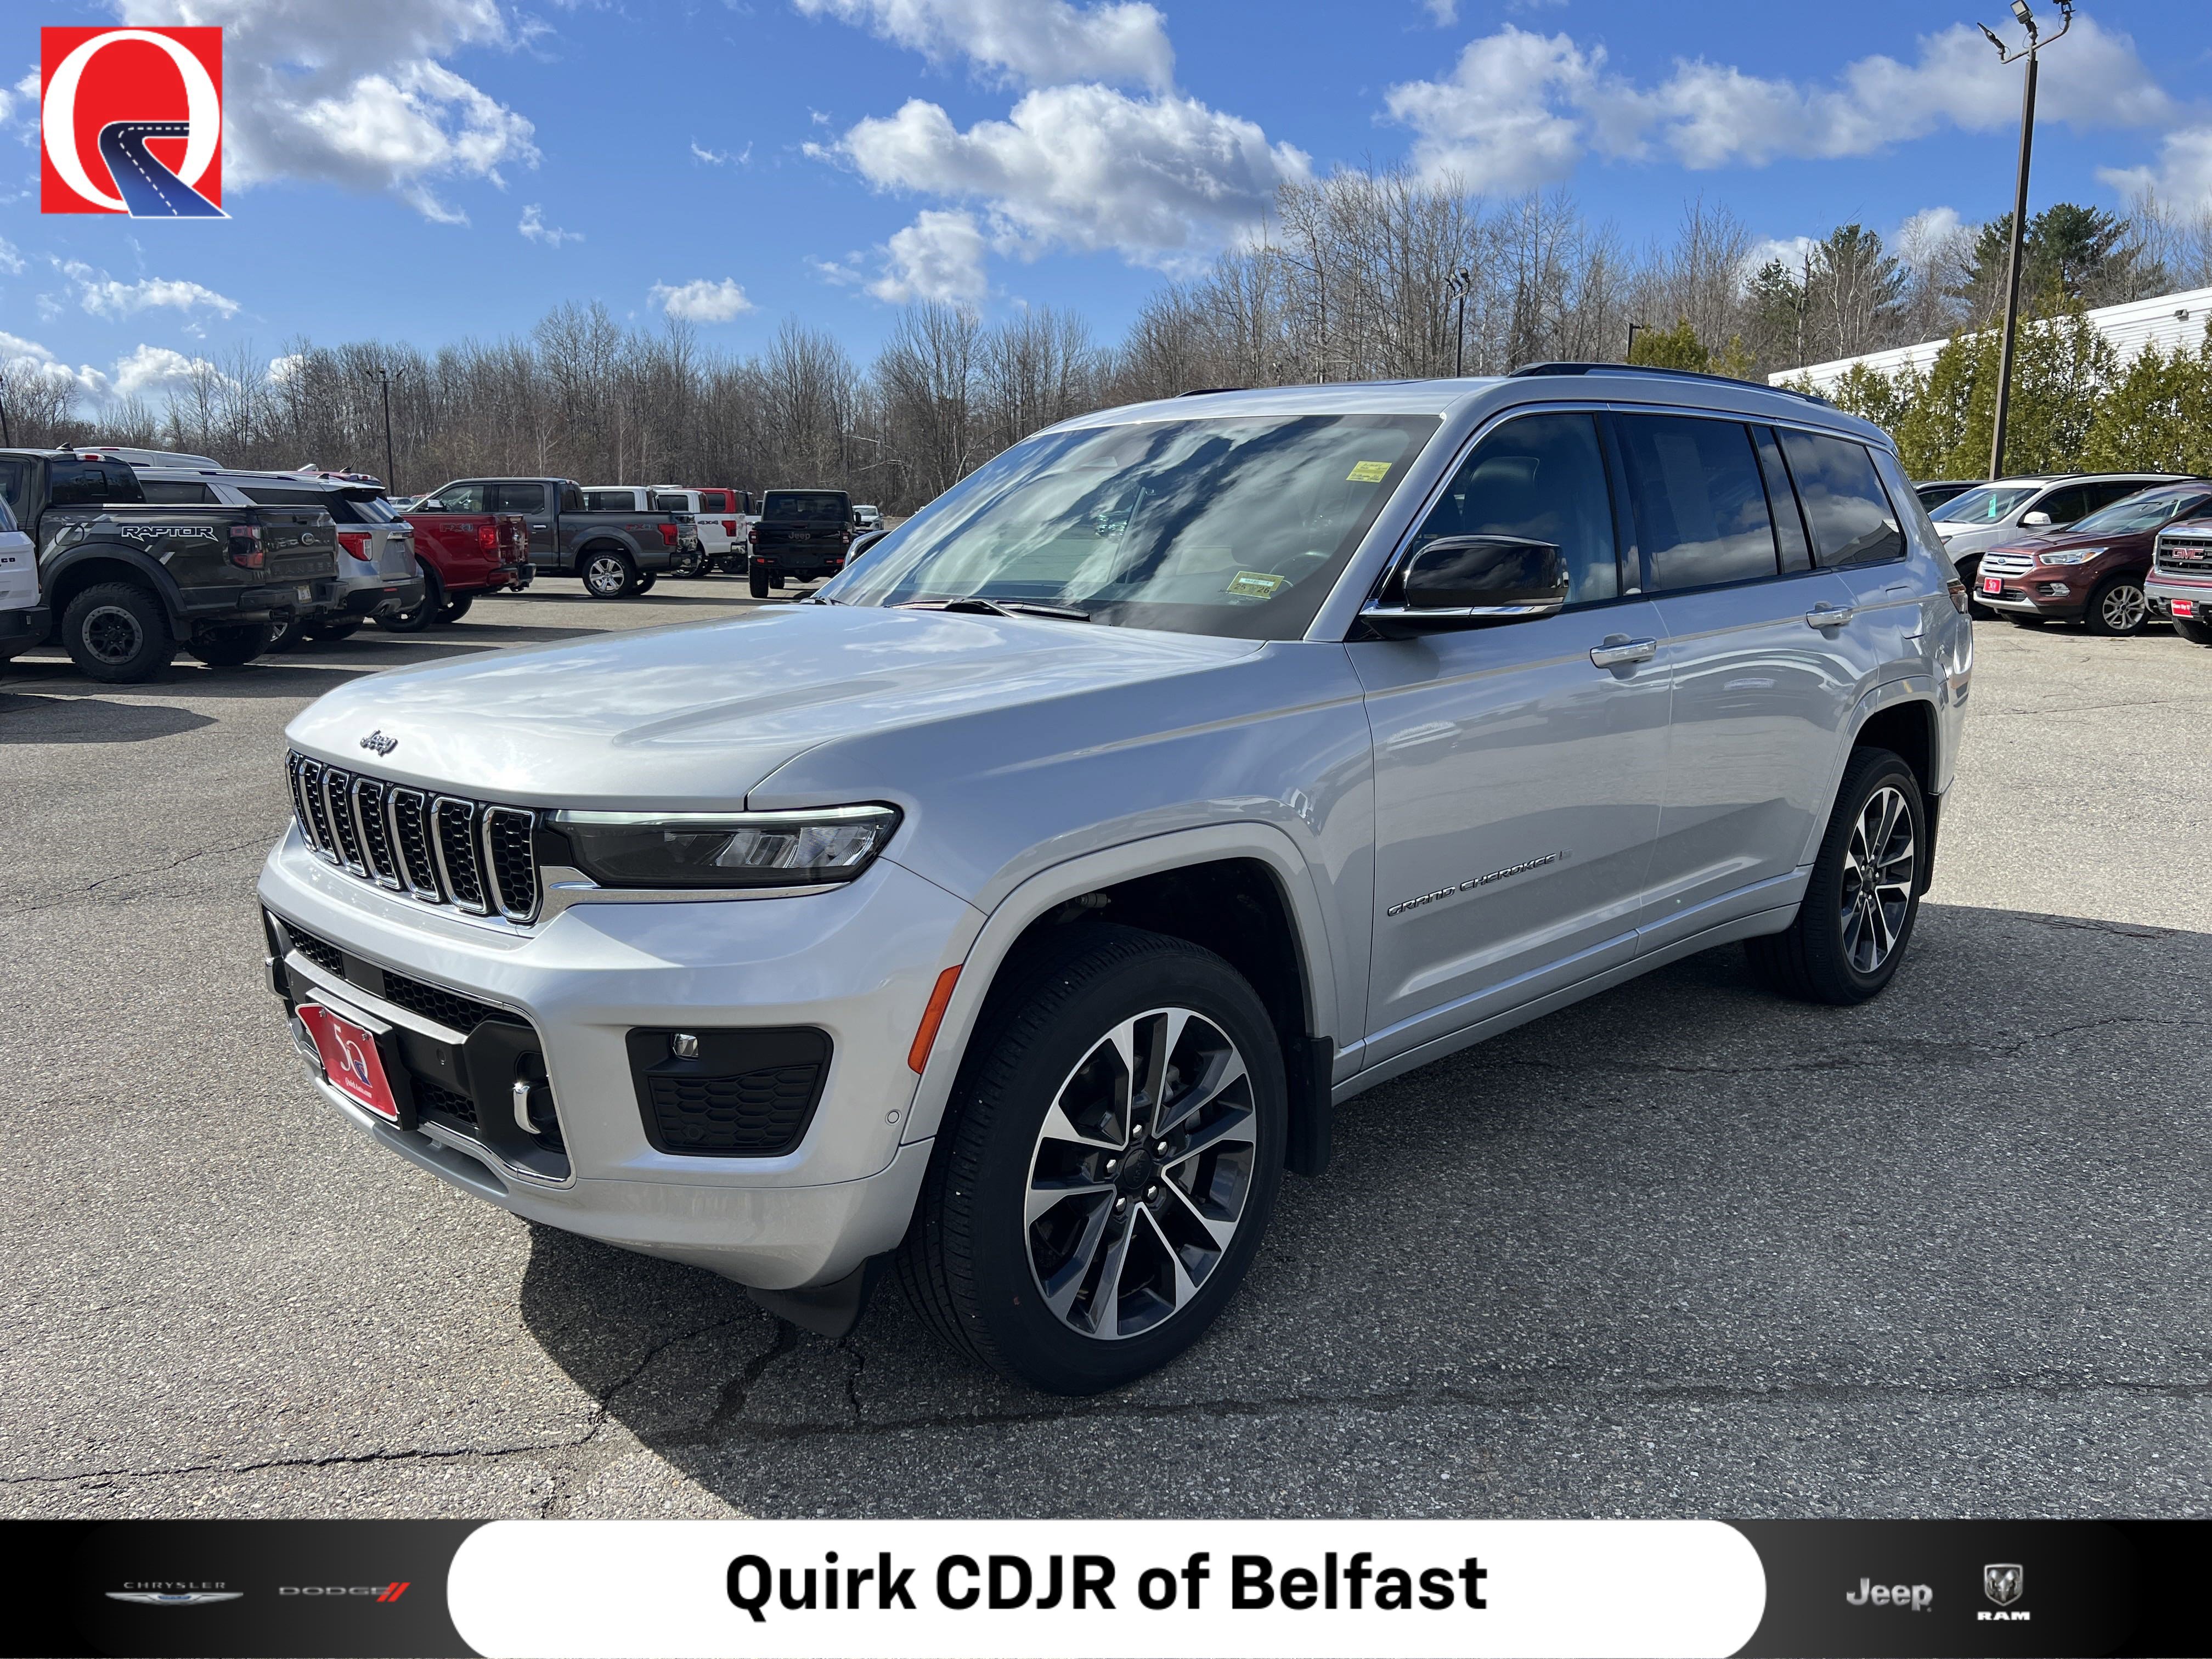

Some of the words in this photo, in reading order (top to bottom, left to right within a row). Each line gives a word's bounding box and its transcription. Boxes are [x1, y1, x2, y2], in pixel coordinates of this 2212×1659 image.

[121, 526, 218, 541] RAPTOR
[440, 523, 473, 532] FX4
[788, 532, 811, 540] Jeep
[2172, 547, 2204, 560] GMC
[360, 730, 398, 758] Jeep
[1387, 886, 1455, 917] GRAND
[1460, 853, 1556, 892] CHEROKEE
